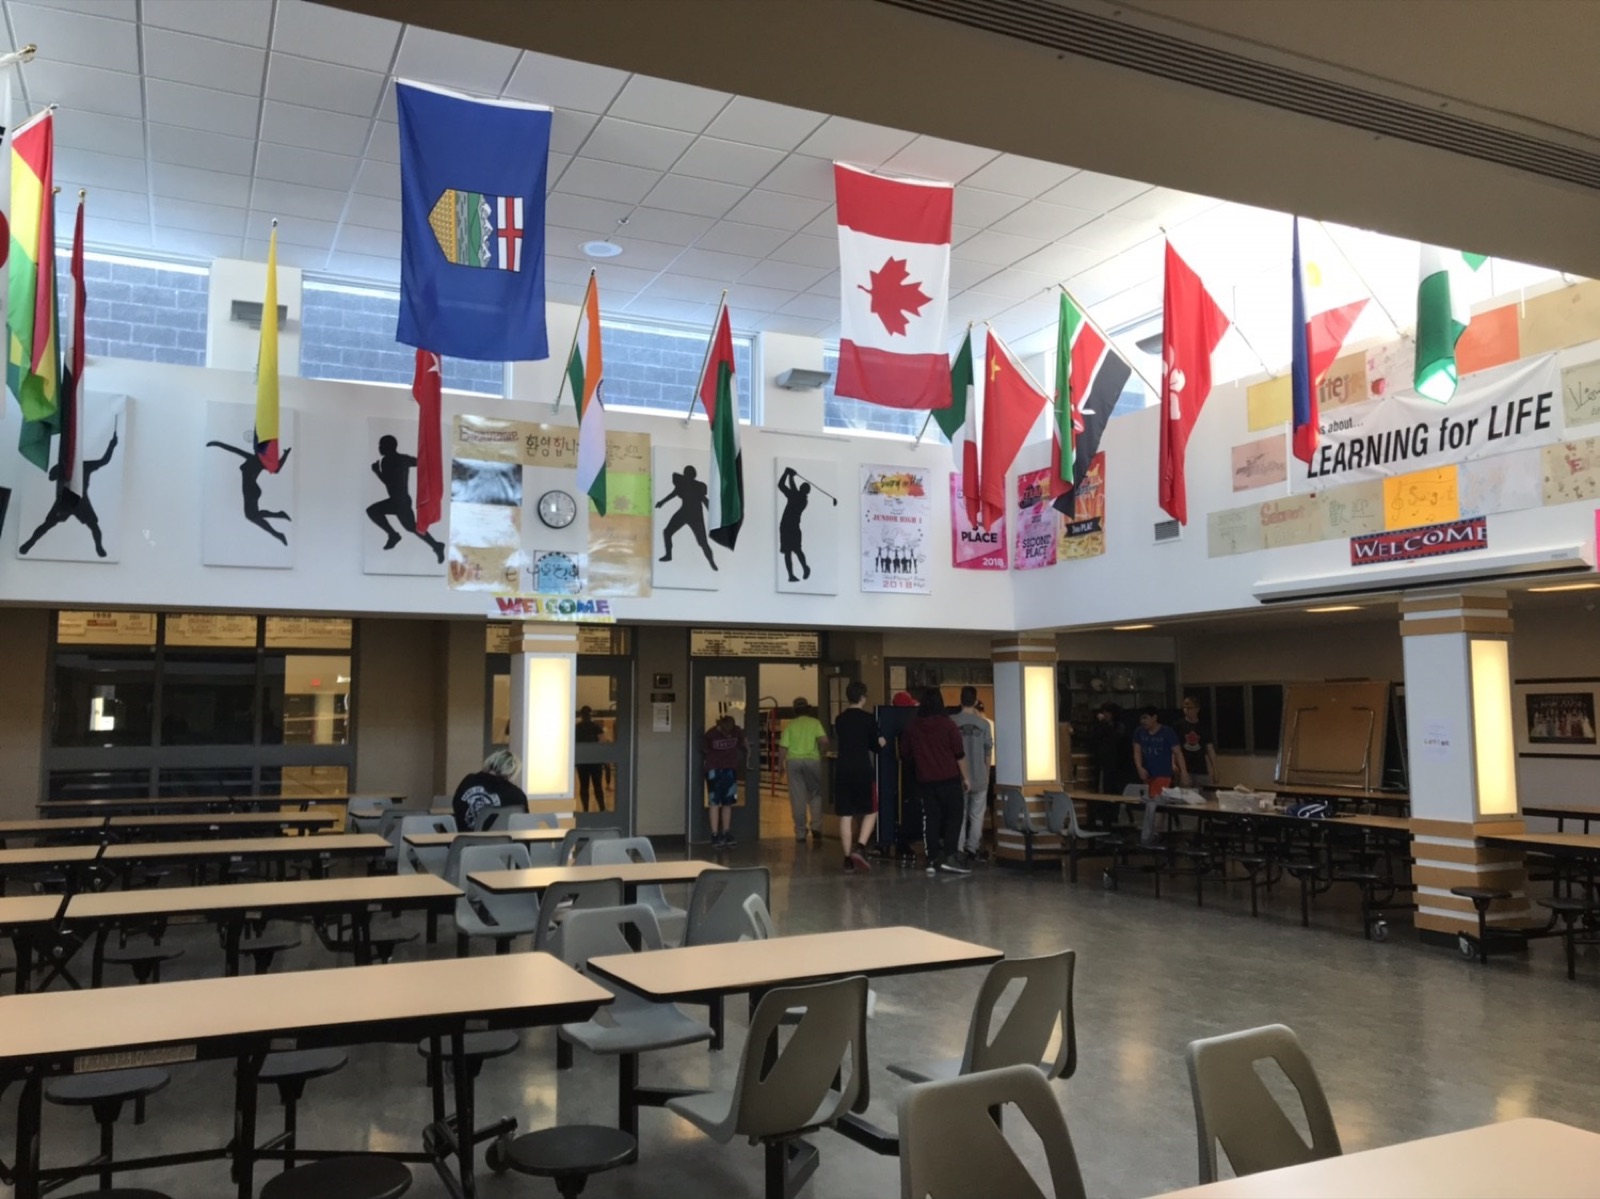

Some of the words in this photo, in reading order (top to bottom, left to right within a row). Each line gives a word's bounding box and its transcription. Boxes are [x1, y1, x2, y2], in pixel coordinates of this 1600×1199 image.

[1307, 422, 1428, 479] LEARNING
[1439, 416, 1479, 451] for
[1487, 392, 1553, 440] LIFE
[873, 514, 898, 522] JUNIOR
[961, 531, 998, 543] PLACE
[1354, 526, 1487, 559] WELCOME
[982, 557, 1005, 568] 2018
[882, 580, 913, 589] 2018
[496, 597, 611, 615] WELCOME
